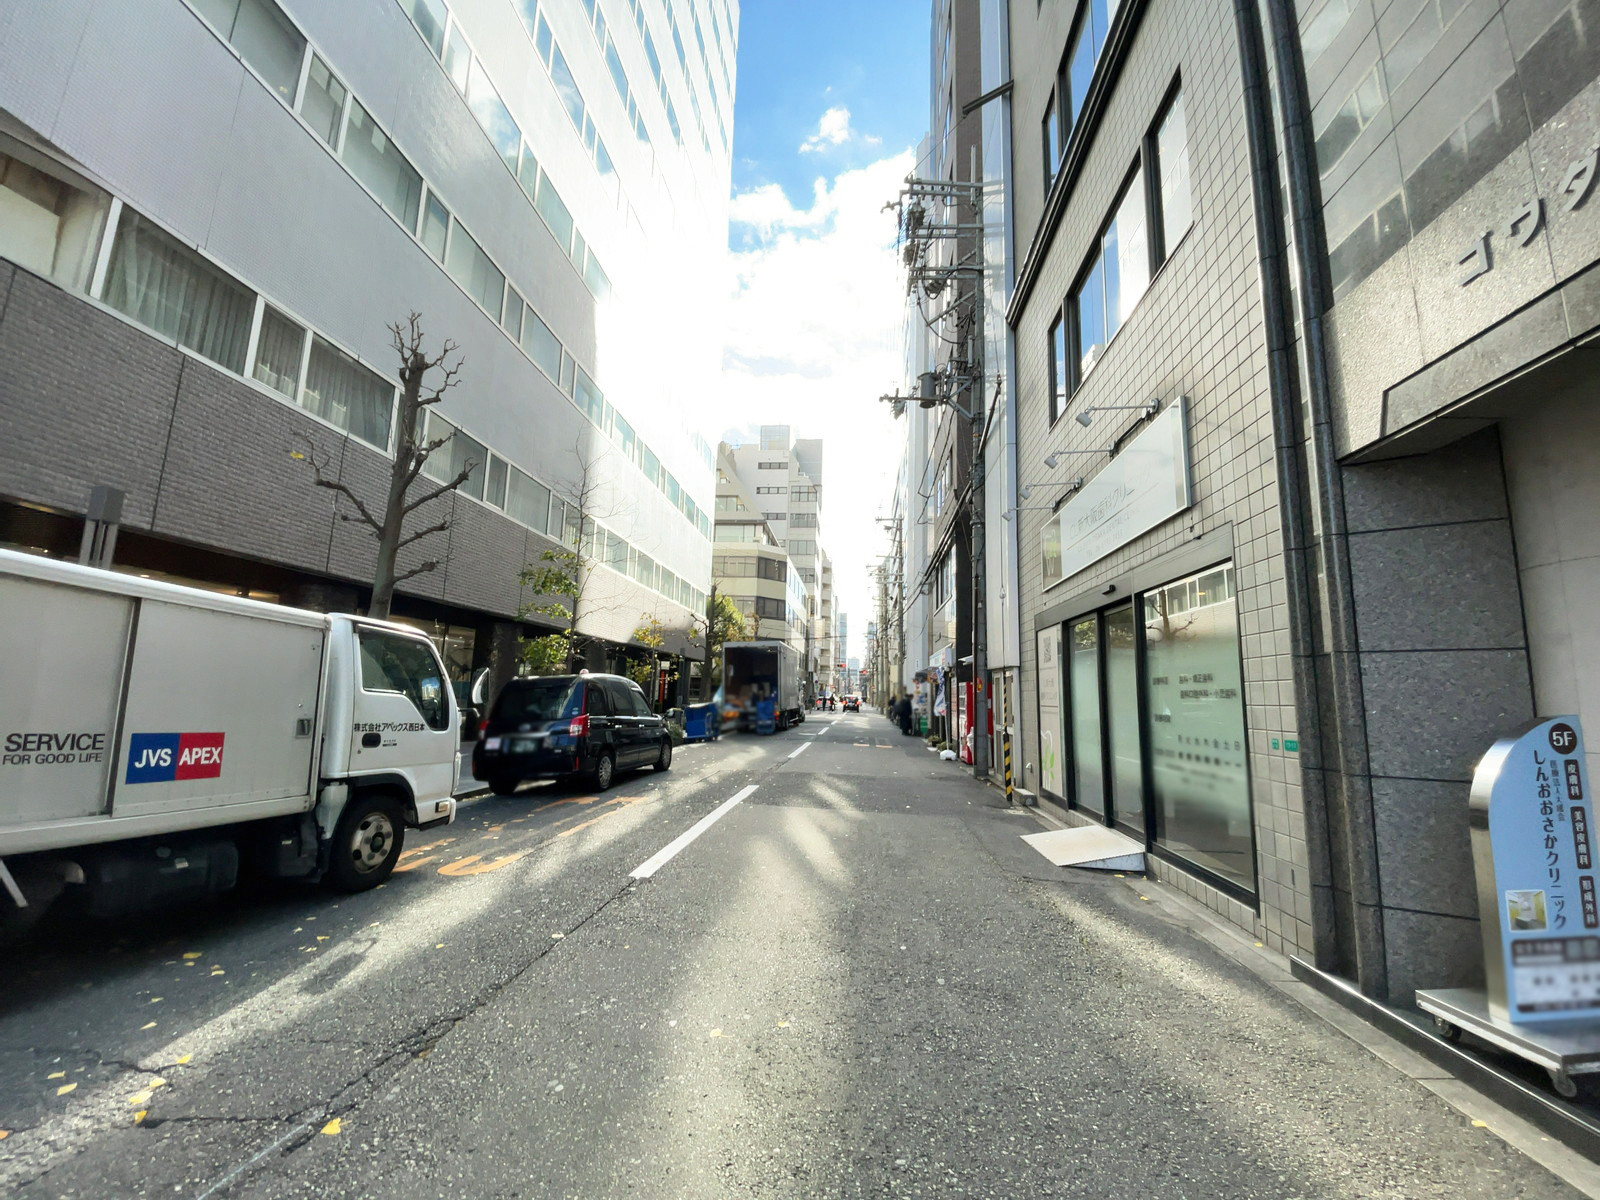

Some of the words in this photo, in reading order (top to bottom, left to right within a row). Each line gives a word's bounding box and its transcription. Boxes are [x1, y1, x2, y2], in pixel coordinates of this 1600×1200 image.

[354, 722, 425, 732] 株式会社アペックス西日本
[4, 733, 105, 752] SERVICE
[1552, 731, 1573, 747] 5F
[2, 754, 31, 765] FOR
[35, 753, 76, 765] GOOD
[79, 752, 103, 763] LIFE
[134, 748, 172, 769] JVS
[179, 746, 222, 767] APEX
[1567, 763, 1580, 796] 皮膚科
[1533, 749, 1566, 930] しんおおさかクリニック
[1573, 811, 1588, 866] 美容皮膚科
